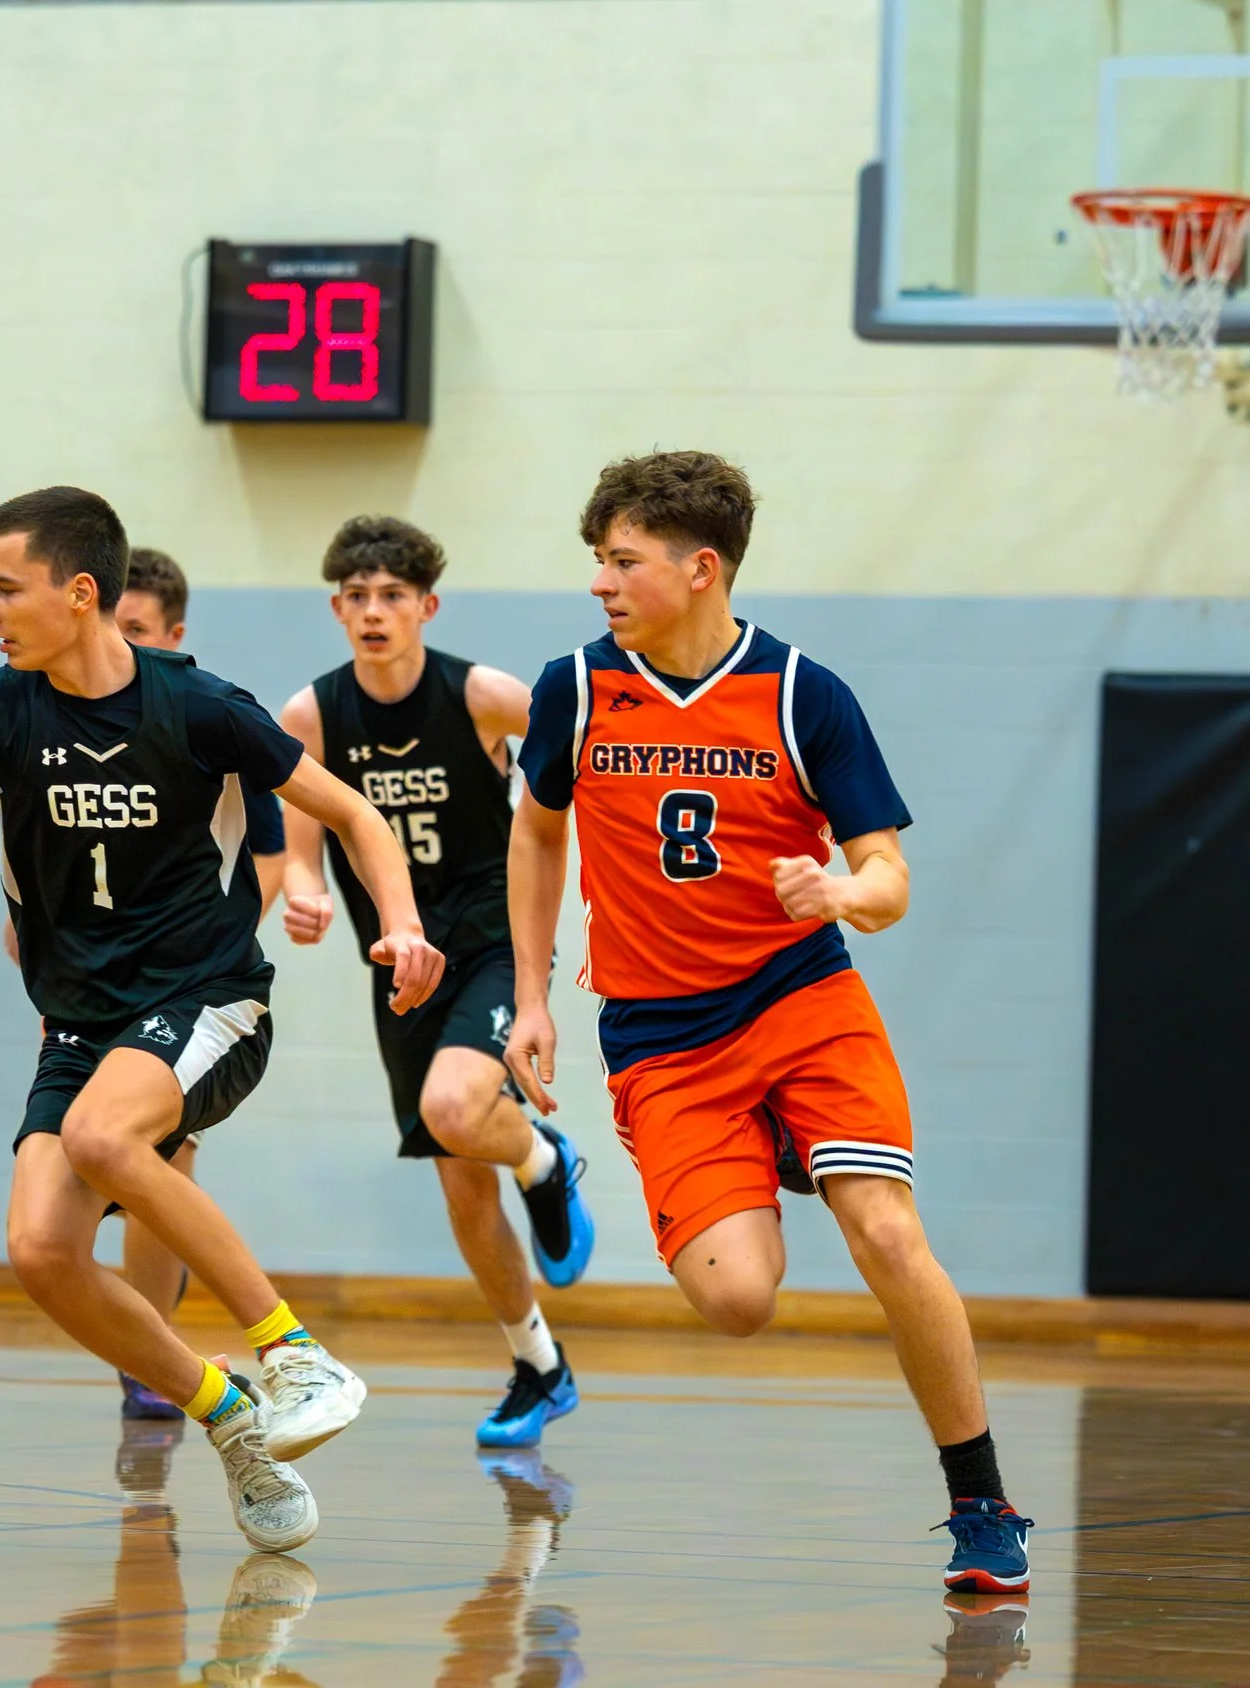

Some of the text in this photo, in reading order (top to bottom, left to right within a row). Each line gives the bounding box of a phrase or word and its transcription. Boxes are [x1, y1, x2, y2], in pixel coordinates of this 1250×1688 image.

[239, 282, 381, 402] 28
[361, 766, 450, 807] GESS
[590, 742, 779, 781] GRYPHONS
[47, 783, 158, 828] GESS
[656, 788, 722, 883] 8
[90, 842, 114, 910] 1
